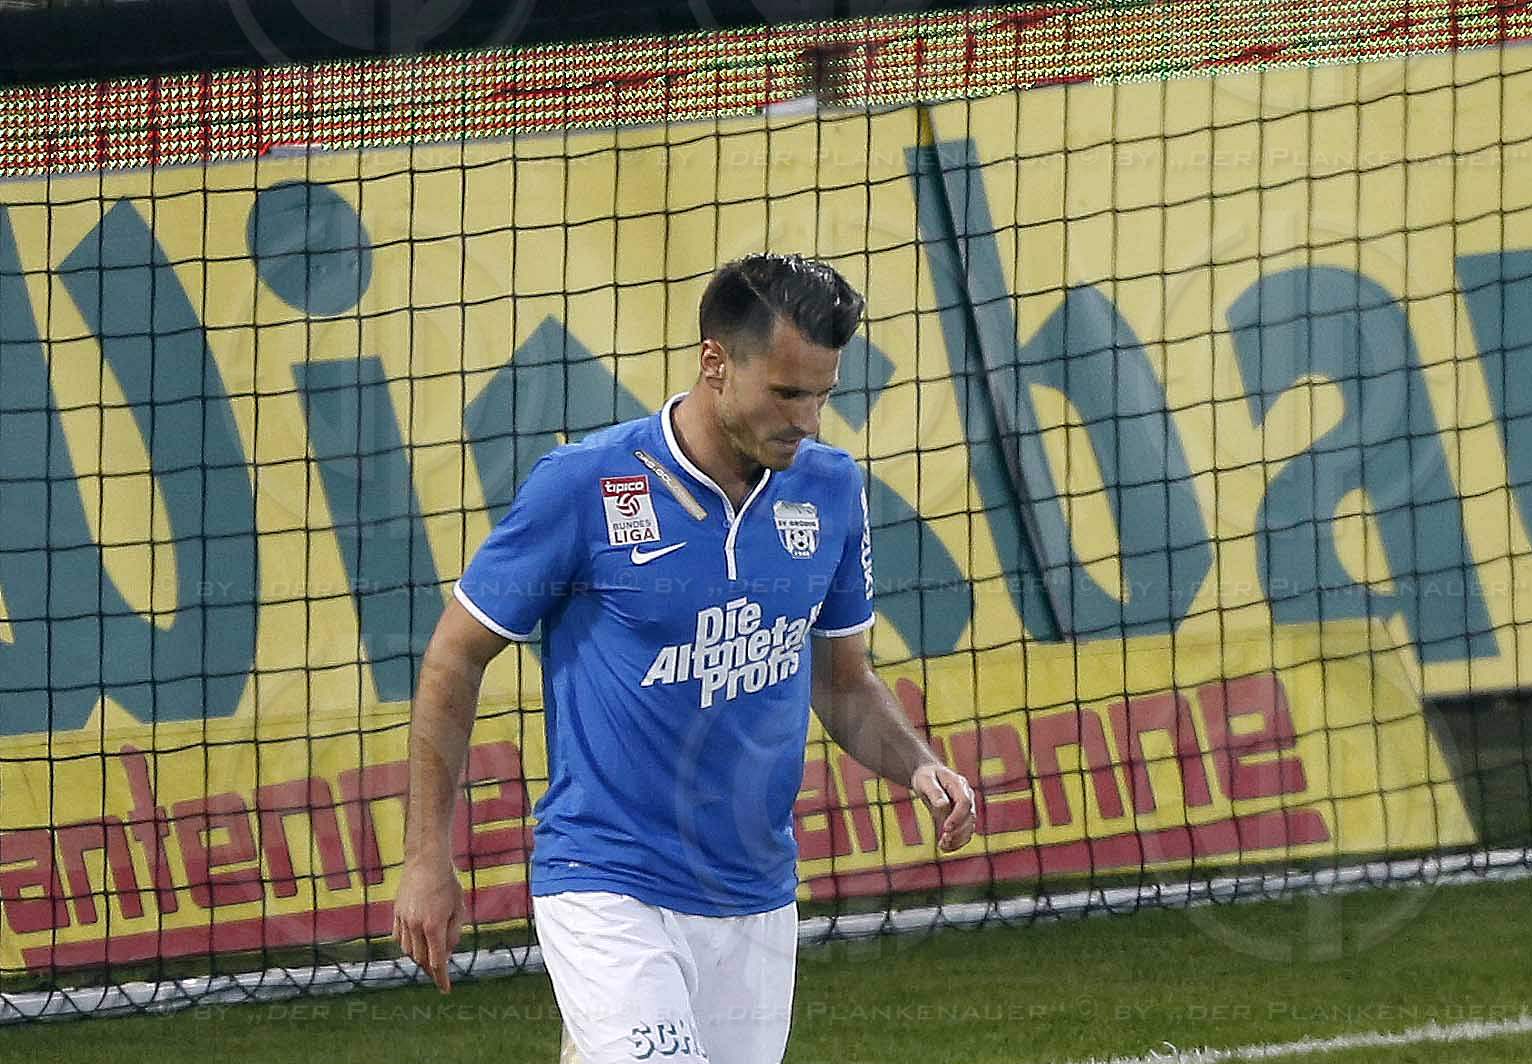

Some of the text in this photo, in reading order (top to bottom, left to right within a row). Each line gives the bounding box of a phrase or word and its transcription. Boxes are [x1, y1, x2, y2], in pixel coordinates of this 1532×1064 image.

[604, 480, 645, 494] tipico
[613, 519, 652, 531] BUNDES
[614, 527, 655, 544] LIGA
[696, 596, 762, 648] Die
